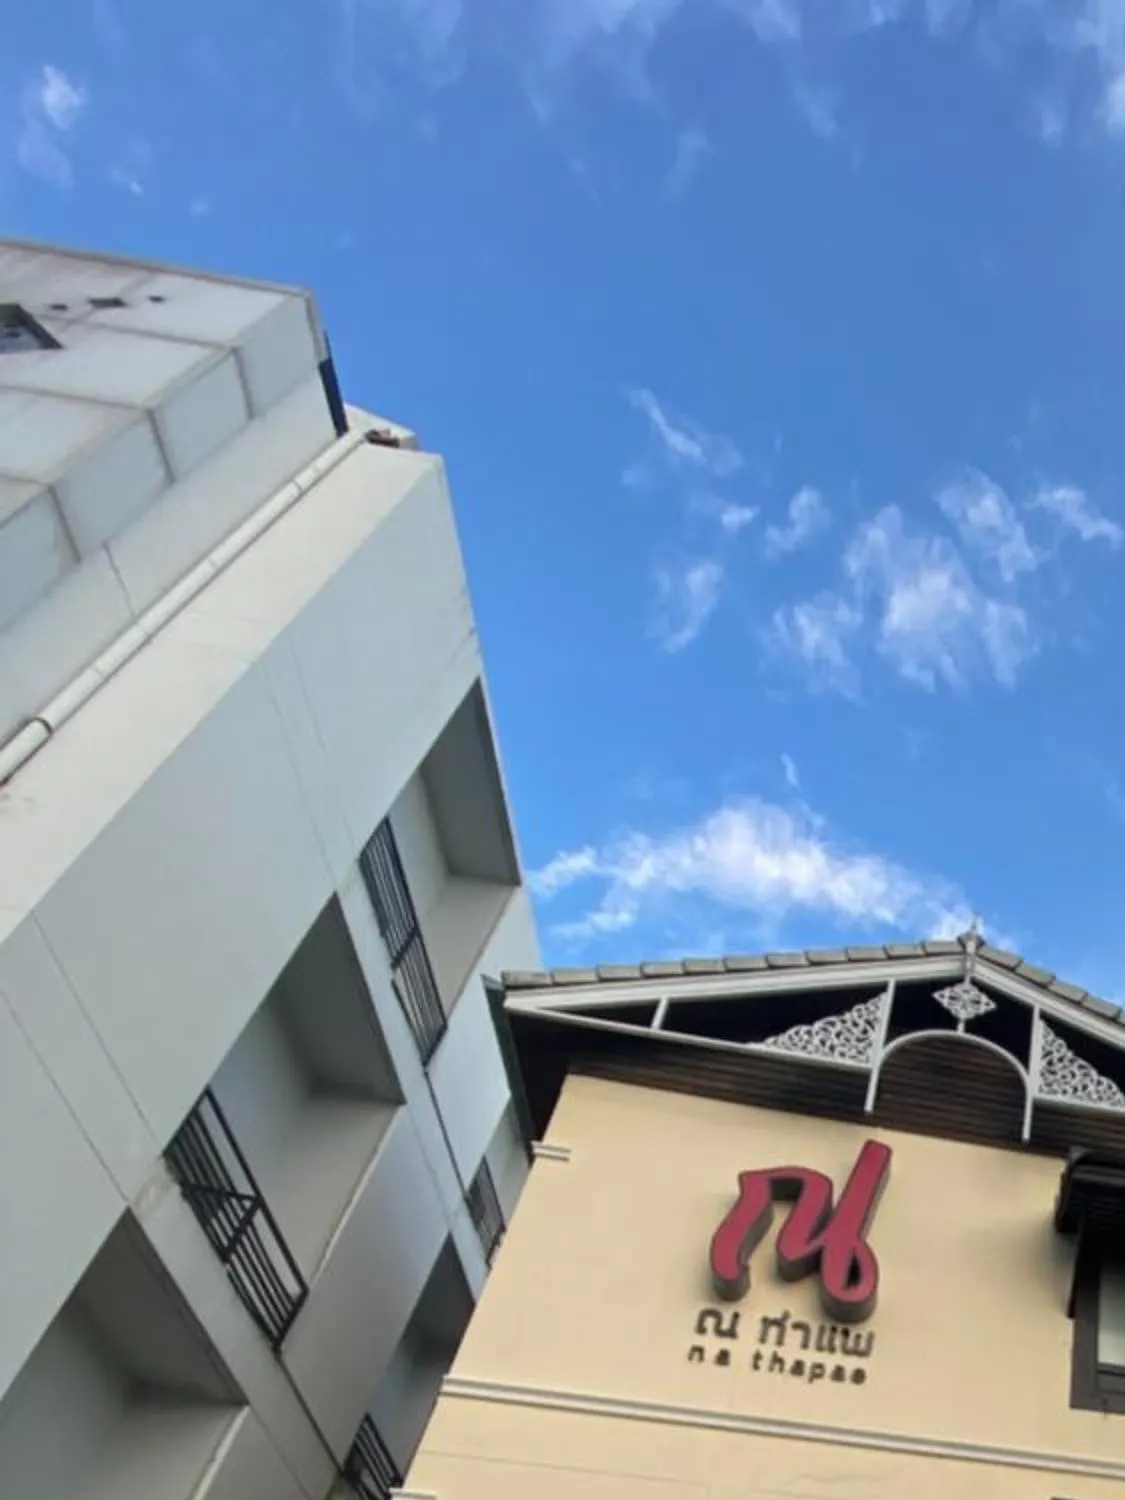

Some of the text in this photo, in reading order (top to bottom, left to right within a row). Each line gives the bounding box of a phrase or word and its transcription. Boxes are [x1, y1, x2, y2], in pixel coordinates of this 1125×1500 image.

[694, 1307, 875, 1358] ณ ท่าแพ
[687, 1344, 731, 1367] na
